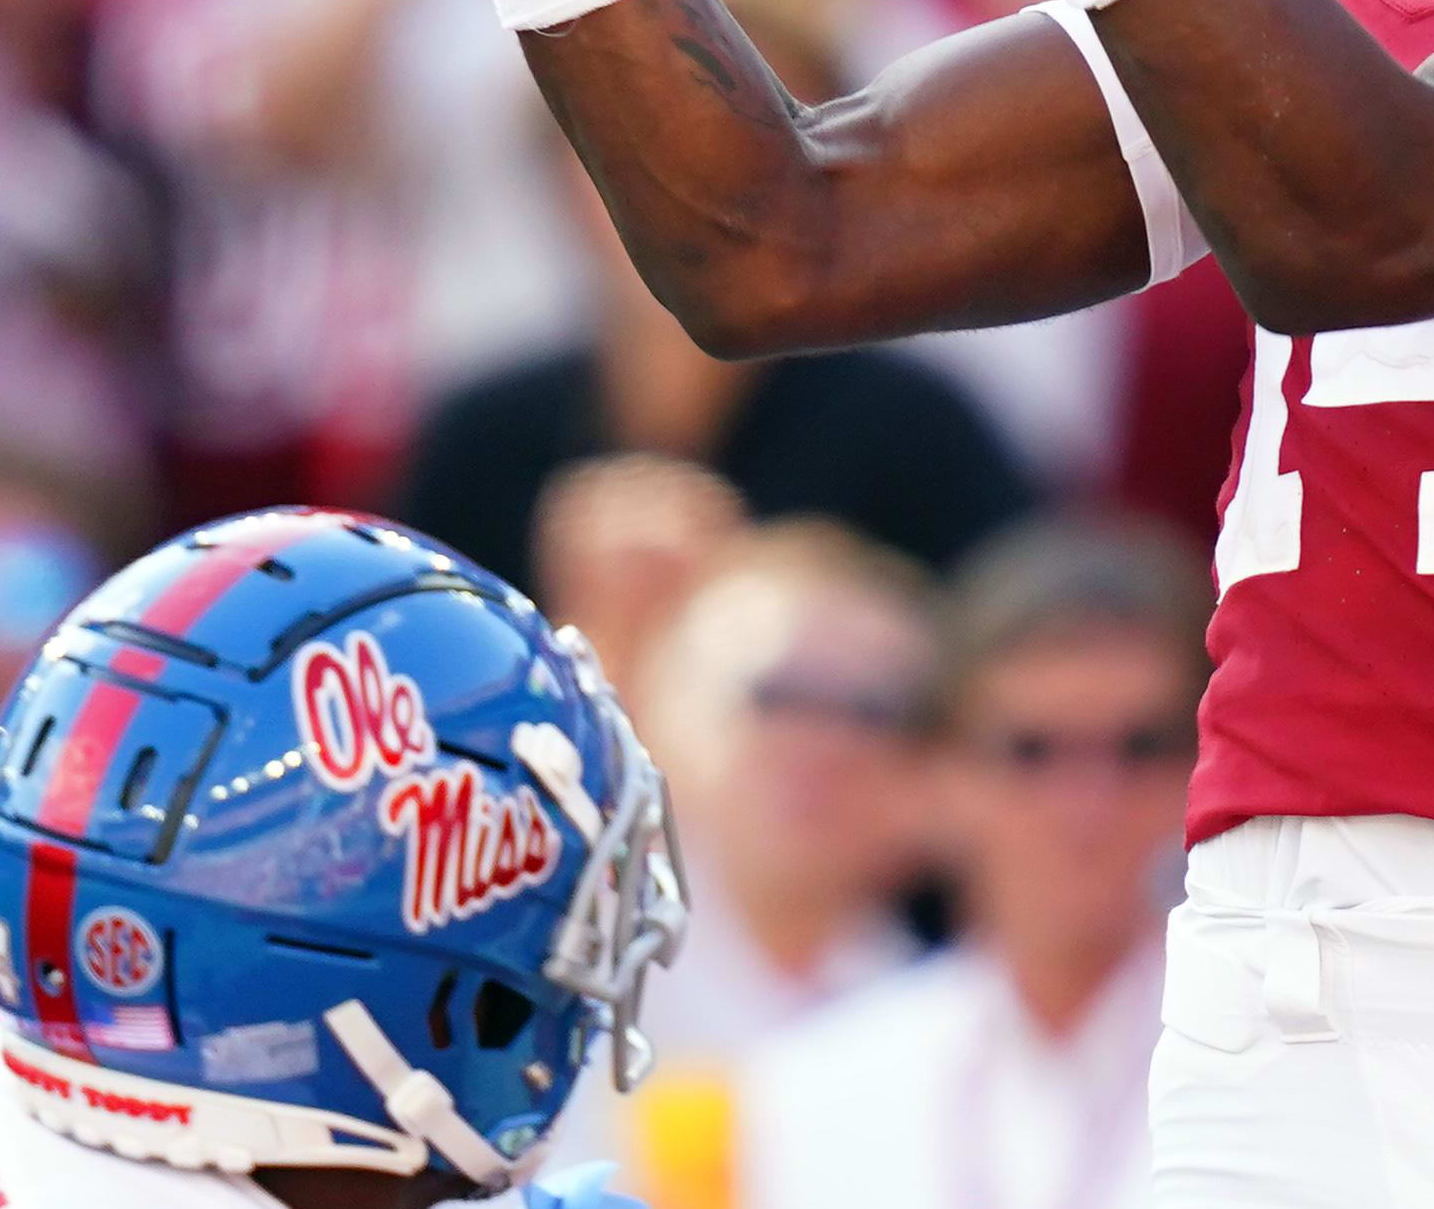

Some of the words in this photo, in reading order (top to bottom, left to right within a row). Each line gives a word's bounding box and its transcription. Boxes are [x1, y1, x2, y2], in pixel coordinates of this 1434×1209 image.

[298, 636, 431, 785] Ole
[382, 766, 555, 929] Miss
[85, 914, 153, 985] SEC
